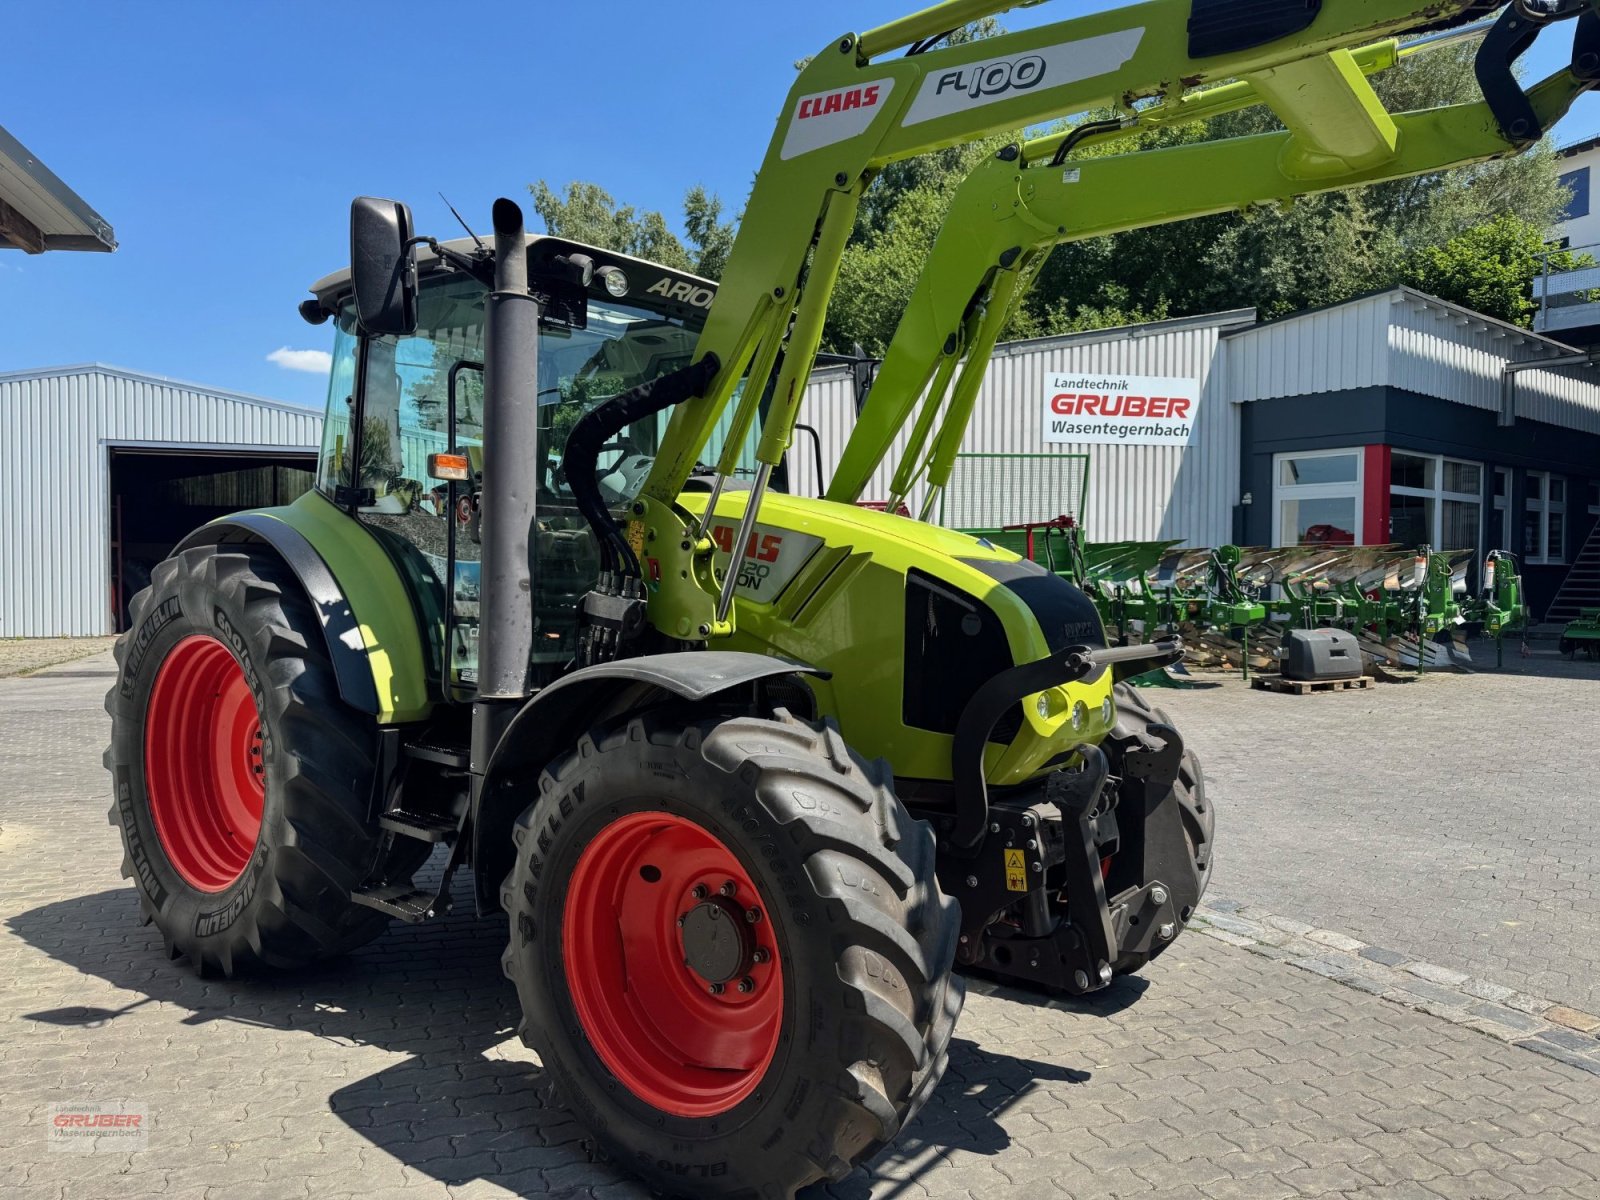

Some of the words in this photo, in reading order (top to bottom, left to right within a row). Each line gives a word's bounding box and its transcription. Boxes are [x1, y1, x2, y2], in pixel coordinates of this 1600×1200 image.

[798, 85, 880, 120] CLAAS
[1054, 378, 1128, 391] Landtechnik
[1051, 393, 1191, 419] GRUBER
[1051, 420, 1190, 438] Wasentegernbach
[714, 566, 762, 591] AON
[741, 560, 770, 579] 20
[127, 596, 181, 673] MICHELIN
[119, 781, 162, 901] MULTIBIB
[199, 868, 257, 937] MICHELIN
